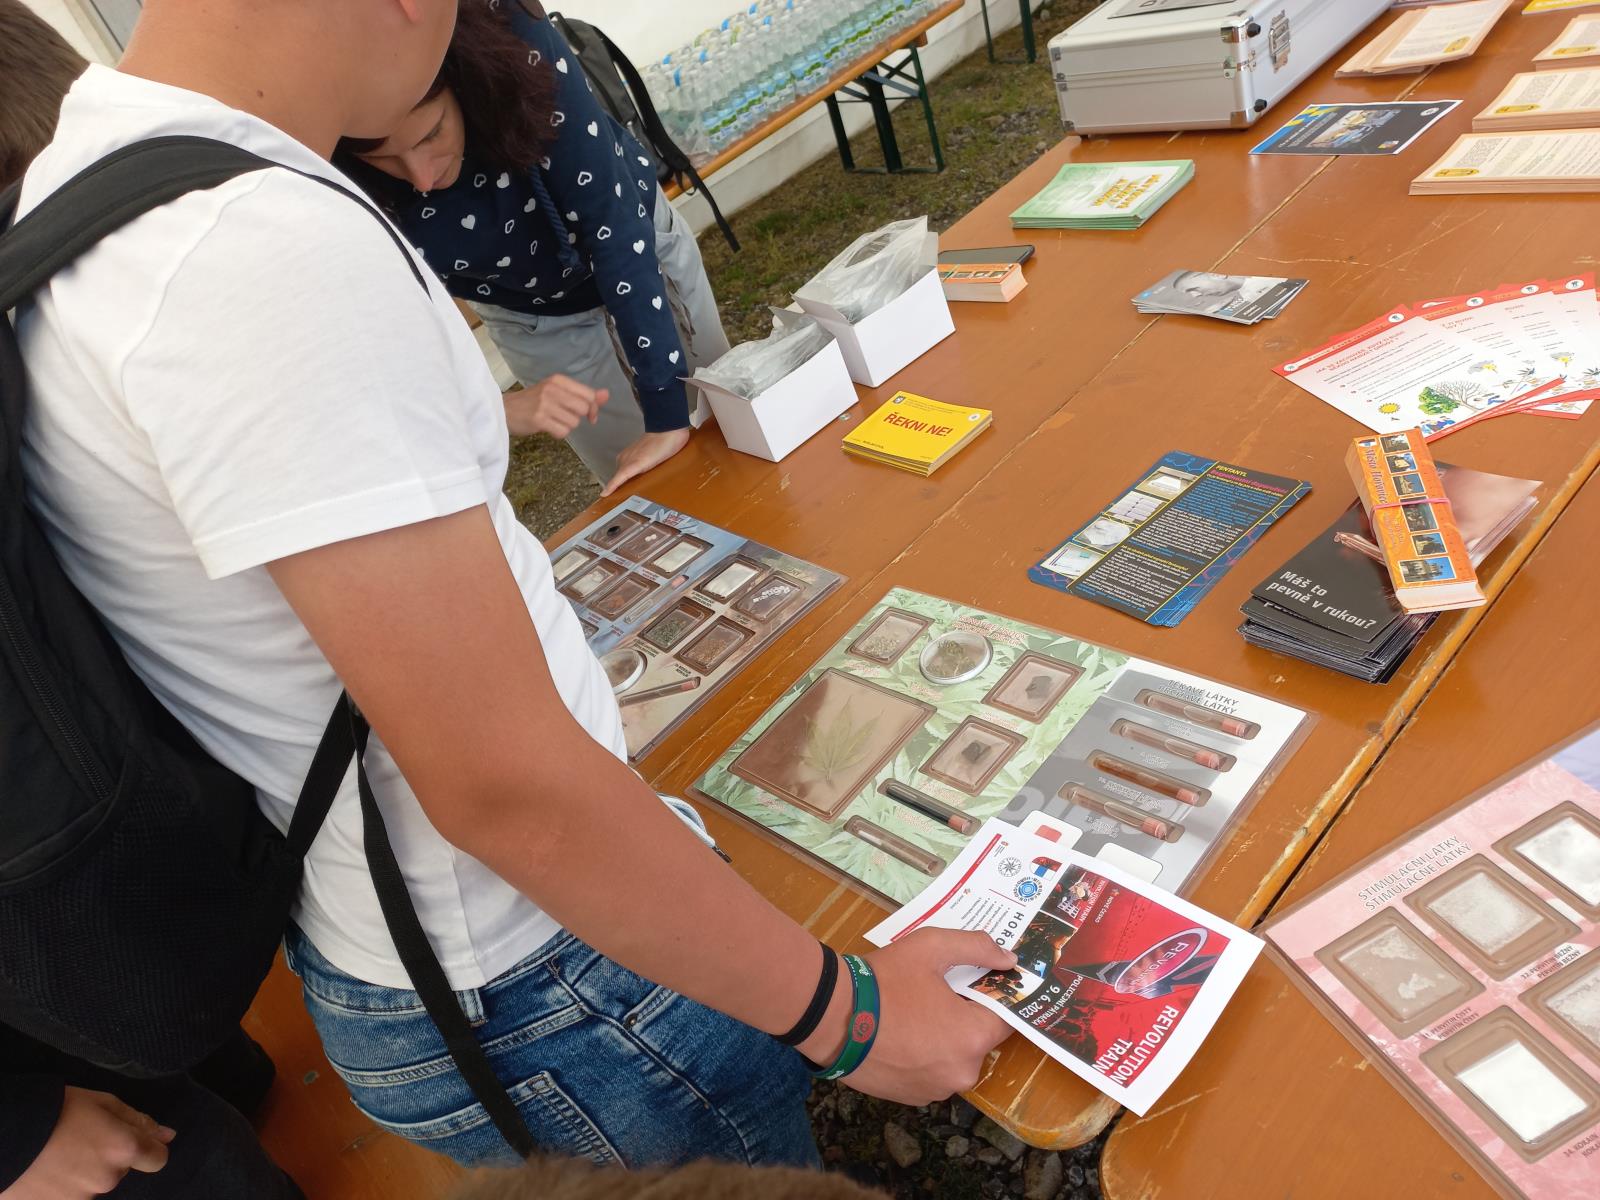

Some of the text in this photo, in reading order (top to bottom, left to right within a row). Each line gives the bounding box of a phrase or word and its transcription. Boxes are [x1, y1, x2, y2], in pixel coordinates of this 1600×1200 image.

[883, 411, 953, 437] ŘEKNI NE!
[1214, 464, 1249, 478] FENTANYL
[1279, 571, 1328, 596] Máš to
[1265, 582, 1311, 603] pevně
[1311, 600, 1323, 609] v
[1322, 605, 1377, 629] rukou?
[995, 911, 1025, 946] HOŘO
[1018, 984, 1060, 1019] 9. 6. 2023
[1057, 974, 1083, 1008] POLICEJNÍ
[1031, 1004, 1059, 1026] PÁTRAČKA
[1091, 1037, 1133, 1075] TRAIN
[1110, 1004, 1180, 1088] REVOLUTION
